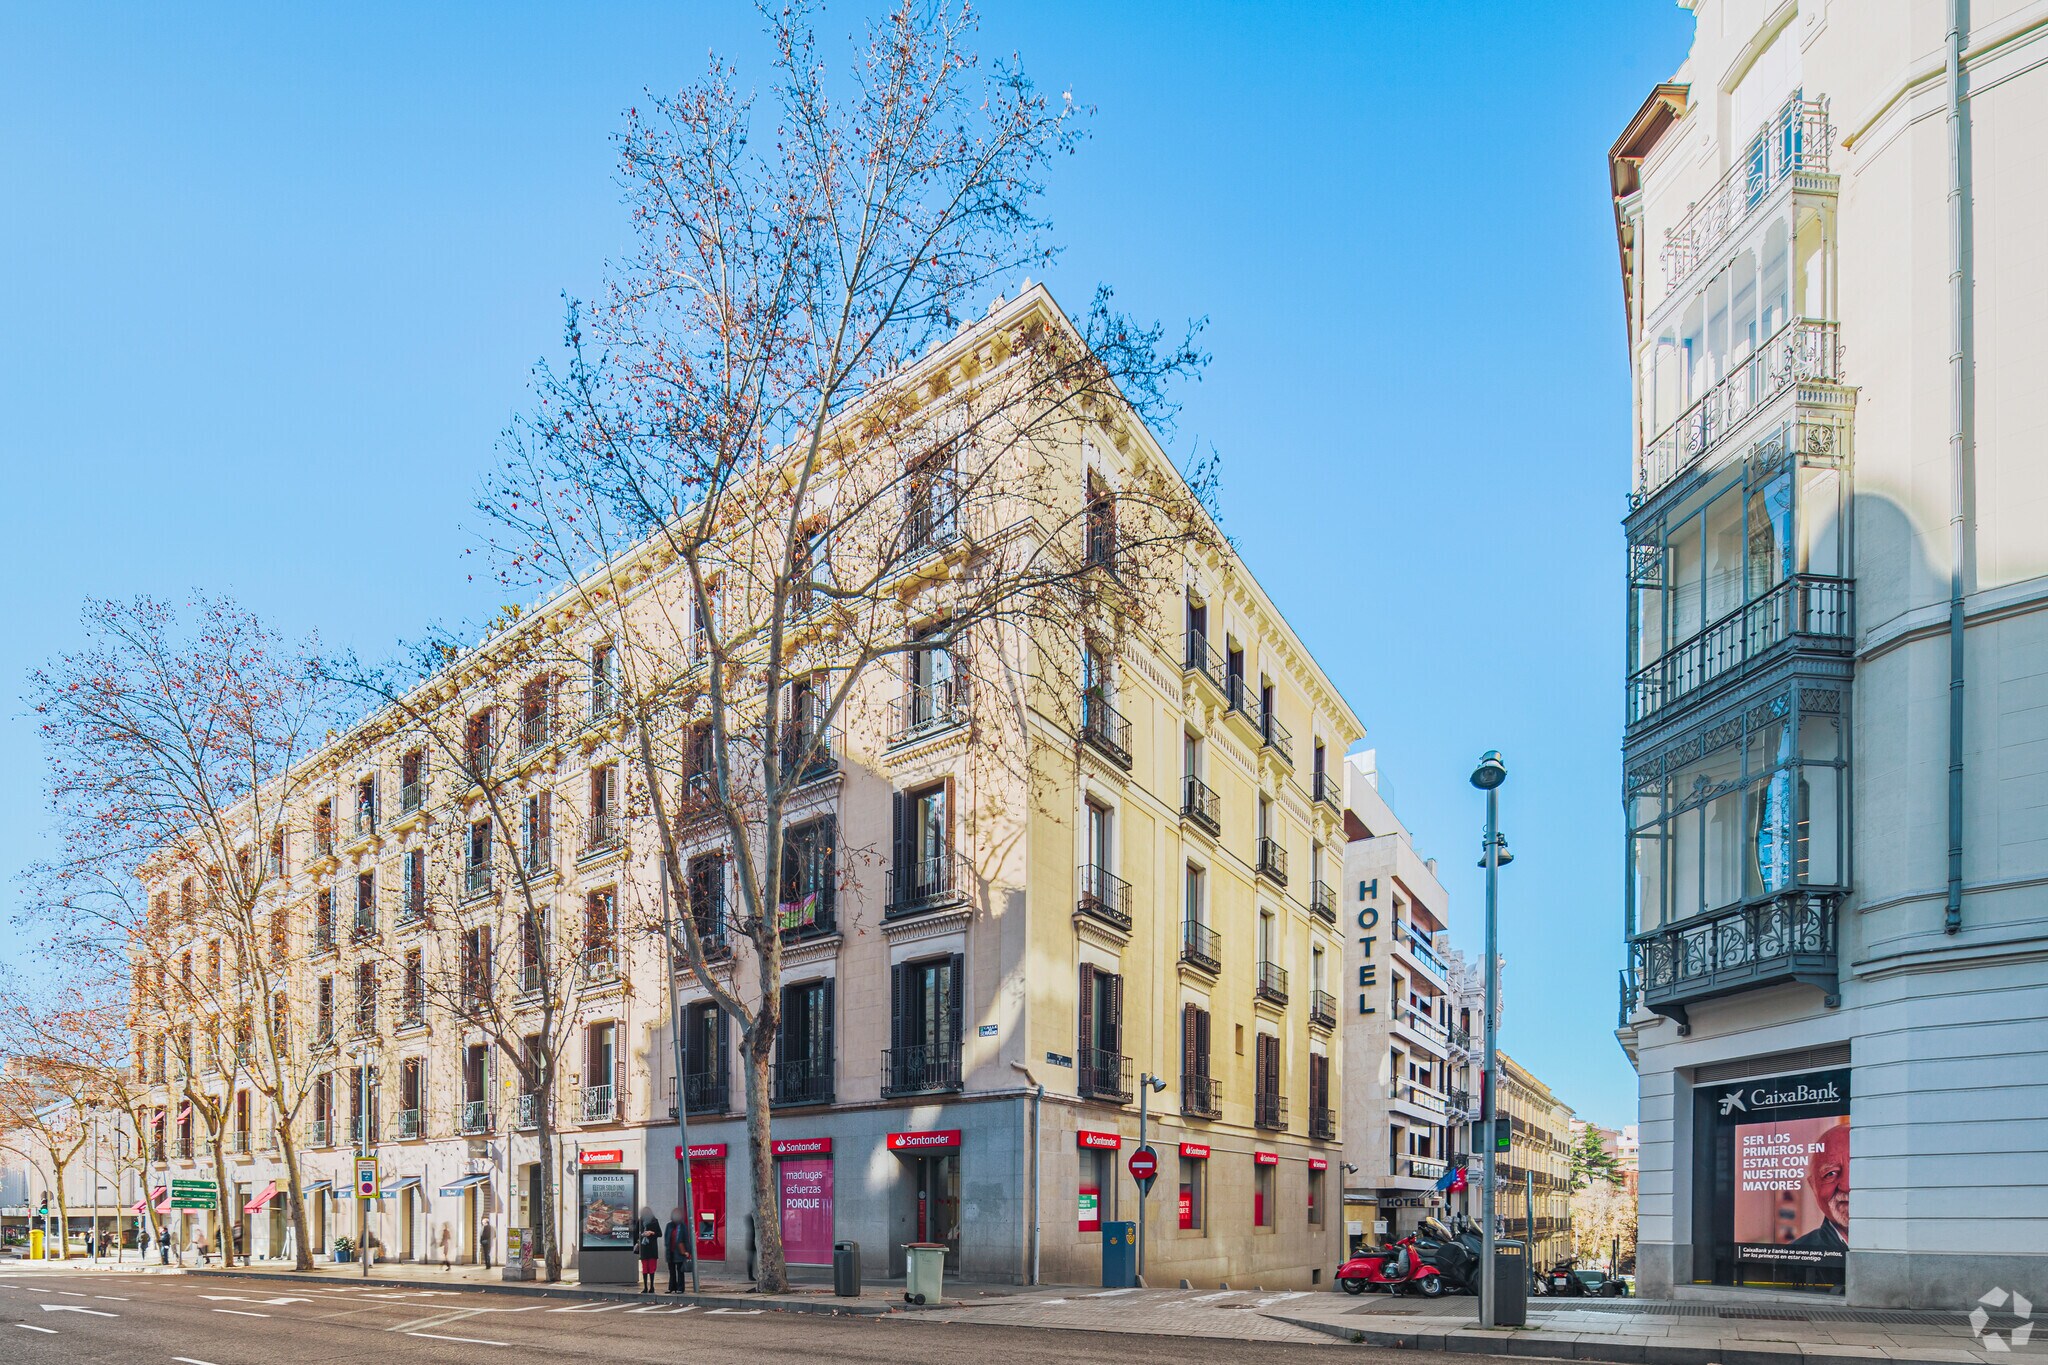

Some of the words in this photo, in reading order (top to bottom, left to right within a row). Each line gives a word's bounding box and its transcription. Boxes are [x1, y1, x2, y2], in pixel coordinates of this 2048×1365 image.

[1357, 878, 1379, 1015] HOTEL
[1751, 1082, 1840, 1105] CaixaBank
[907, 1135, 949, 1146] Santander
[1092, 1135, 1117, 1147] Santander
[1743, 1135, 1764, 1146] SER
[1767, 1133, 1791, 1145] LOS
[688, 1148, 719, 1157] Santander
[786, 1142, 822, 1152] Santander
[1190, 1146, 1208, 1156] Santander
[1743, 1144, 1804, 1157] PRIMEROS
[1807, 1142, 1825, 1154] EN
[590, 1153, 615, 1162] Santander
[1743, 1157, 1779, 1168] ESTAR
[1781, 1156, 1809, 1167] CON
[786, 1170, 823, 1182] madrugas
[1743, 1168, 1805, 1180] NUESTROS
[786, 1184, 822, 1194] esfuerzas
[1743, 1180, 1802, 1191] MAYORES
[786, 1198, 820, 1210] PORQUE
[1386, 1198, 1424, 1207] HOTEL
